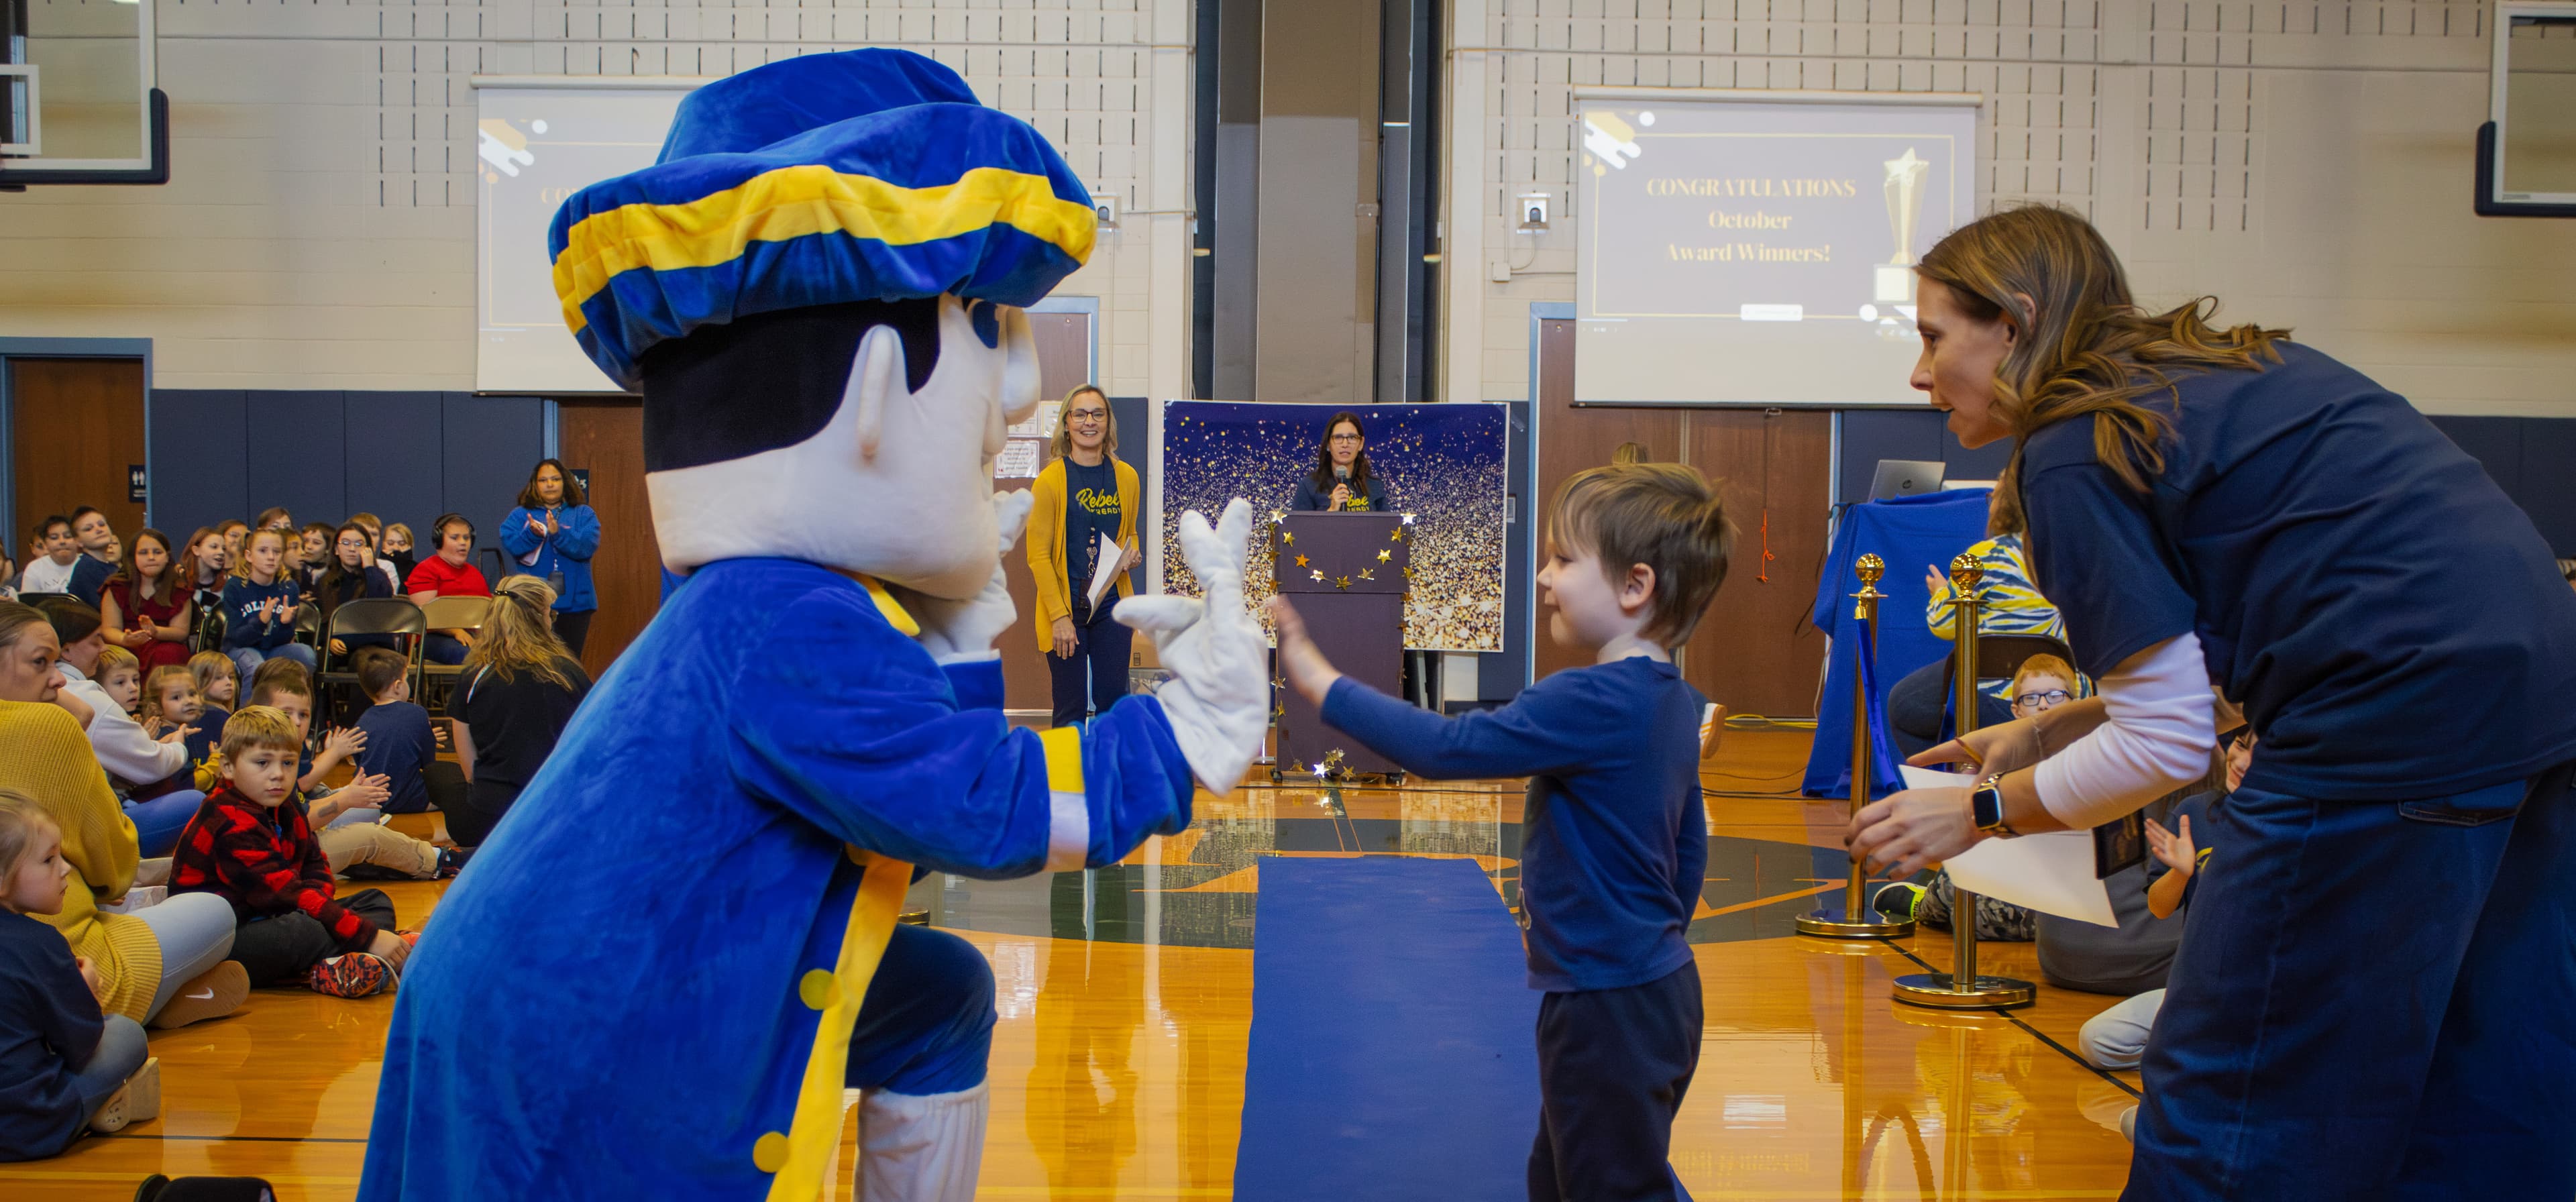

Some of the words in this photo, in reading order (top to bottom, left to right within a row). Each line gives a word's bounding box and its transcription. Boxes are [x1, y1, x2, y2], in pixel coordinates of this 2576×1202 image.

[1646, 178, 1857, 197] CONGRATULATIONS
[1708, 209, 1793, 229] October
[1667, 243, 1732, 262] Award
[1737, 243, 1831, 262] Winners!
[1075, 488, 1120, 512] Rebel
